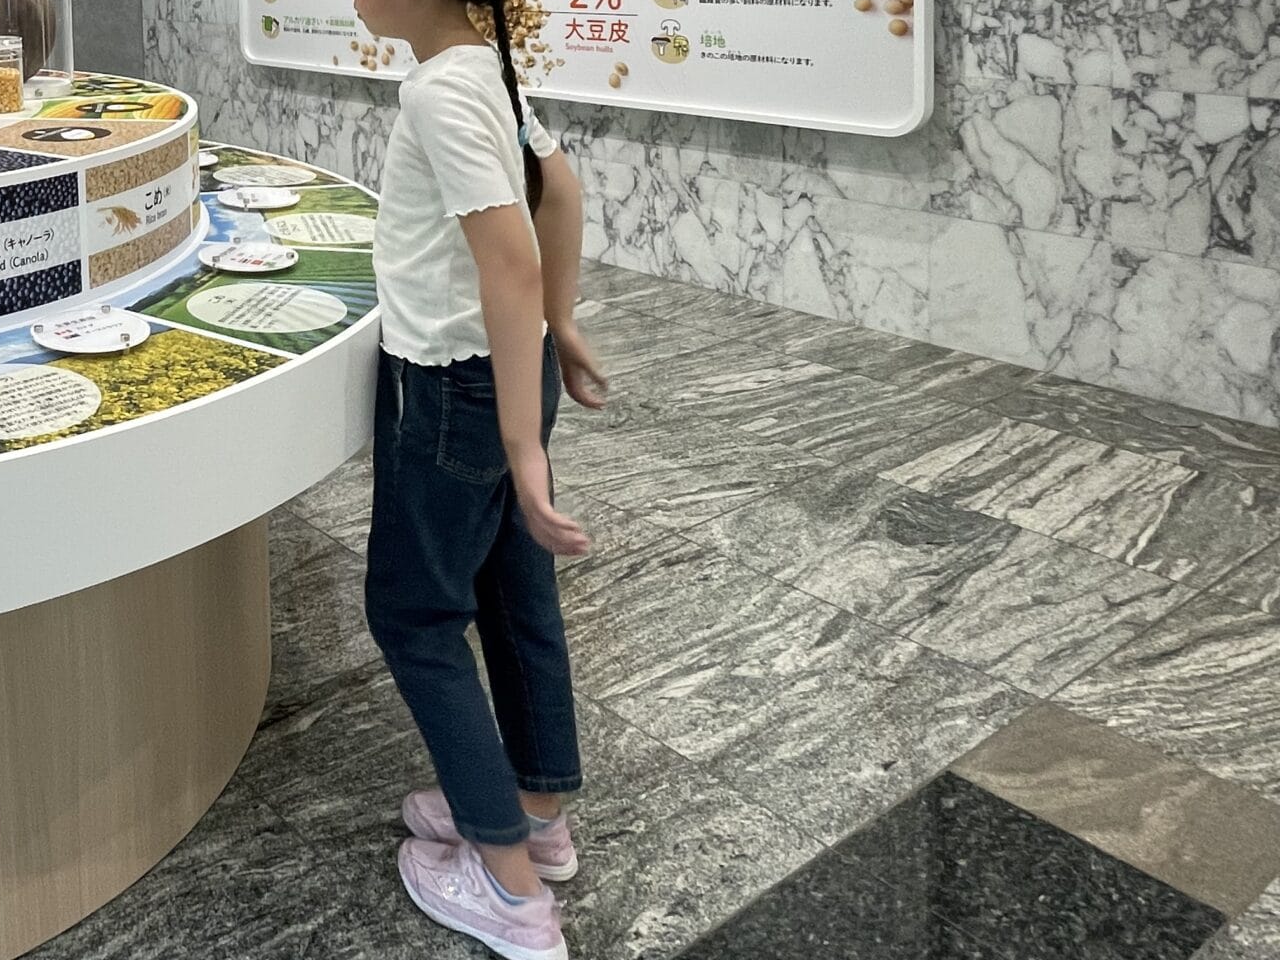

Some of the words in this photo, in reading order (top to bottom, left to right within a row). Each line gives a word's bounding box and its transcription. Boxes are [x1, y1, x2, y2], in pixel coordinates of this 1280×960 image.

[565, 17, 630, 44] 大豆皮
[10, 248, 49, 269] (Canola)
